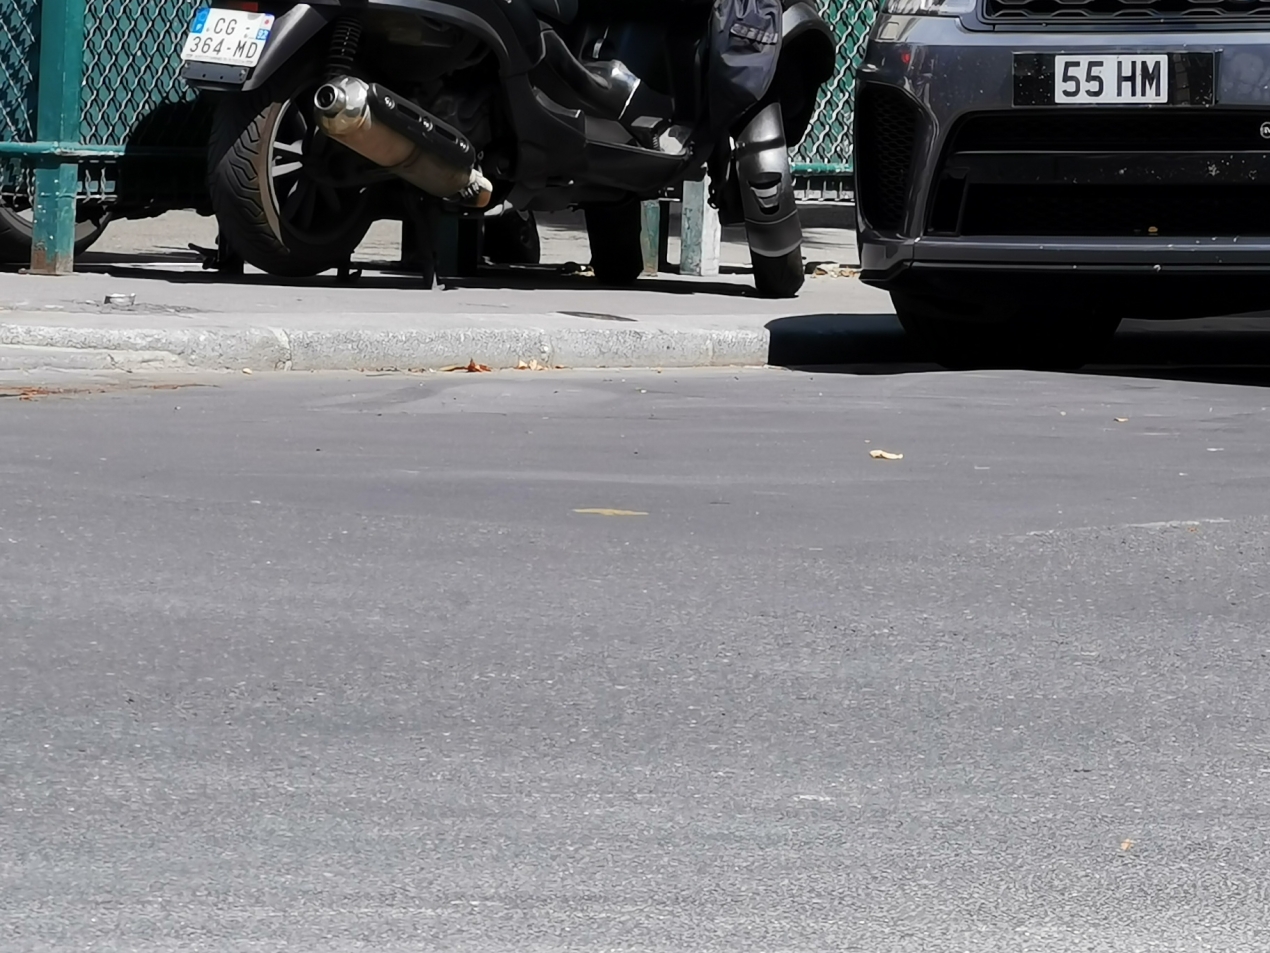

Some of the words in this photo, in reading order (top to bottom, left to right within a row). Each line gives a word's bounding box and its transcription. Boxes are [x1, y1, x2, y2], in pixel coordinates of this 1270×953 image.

[258, 29, 268, 39] 92
[190, 36, 258, 59] 364-MD
[1062, 60, 1104, 97] 55
[1116, 60, 1161, 97] HM
